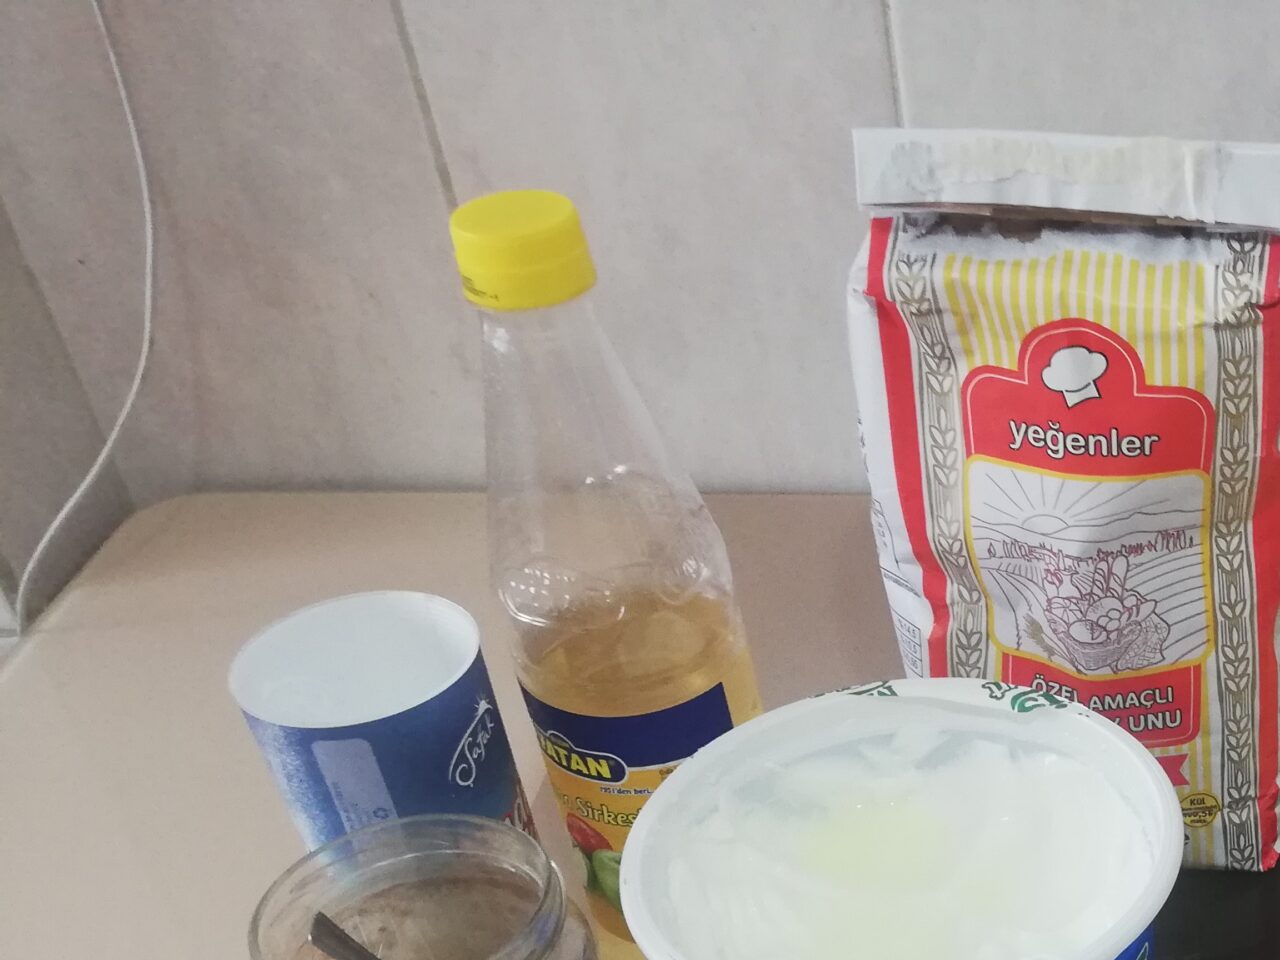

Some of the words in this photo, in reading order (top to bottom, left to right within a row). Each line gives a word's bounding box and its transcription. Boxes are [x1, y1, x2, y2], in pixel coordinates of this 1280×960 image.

[1009, 419, 1161, 459] yeğenler
[1088, 686, 1174, 712] AMAÇLI
[1128, 710, 1183, 732] UNU
[538, 734, 612, 779] ATAN
